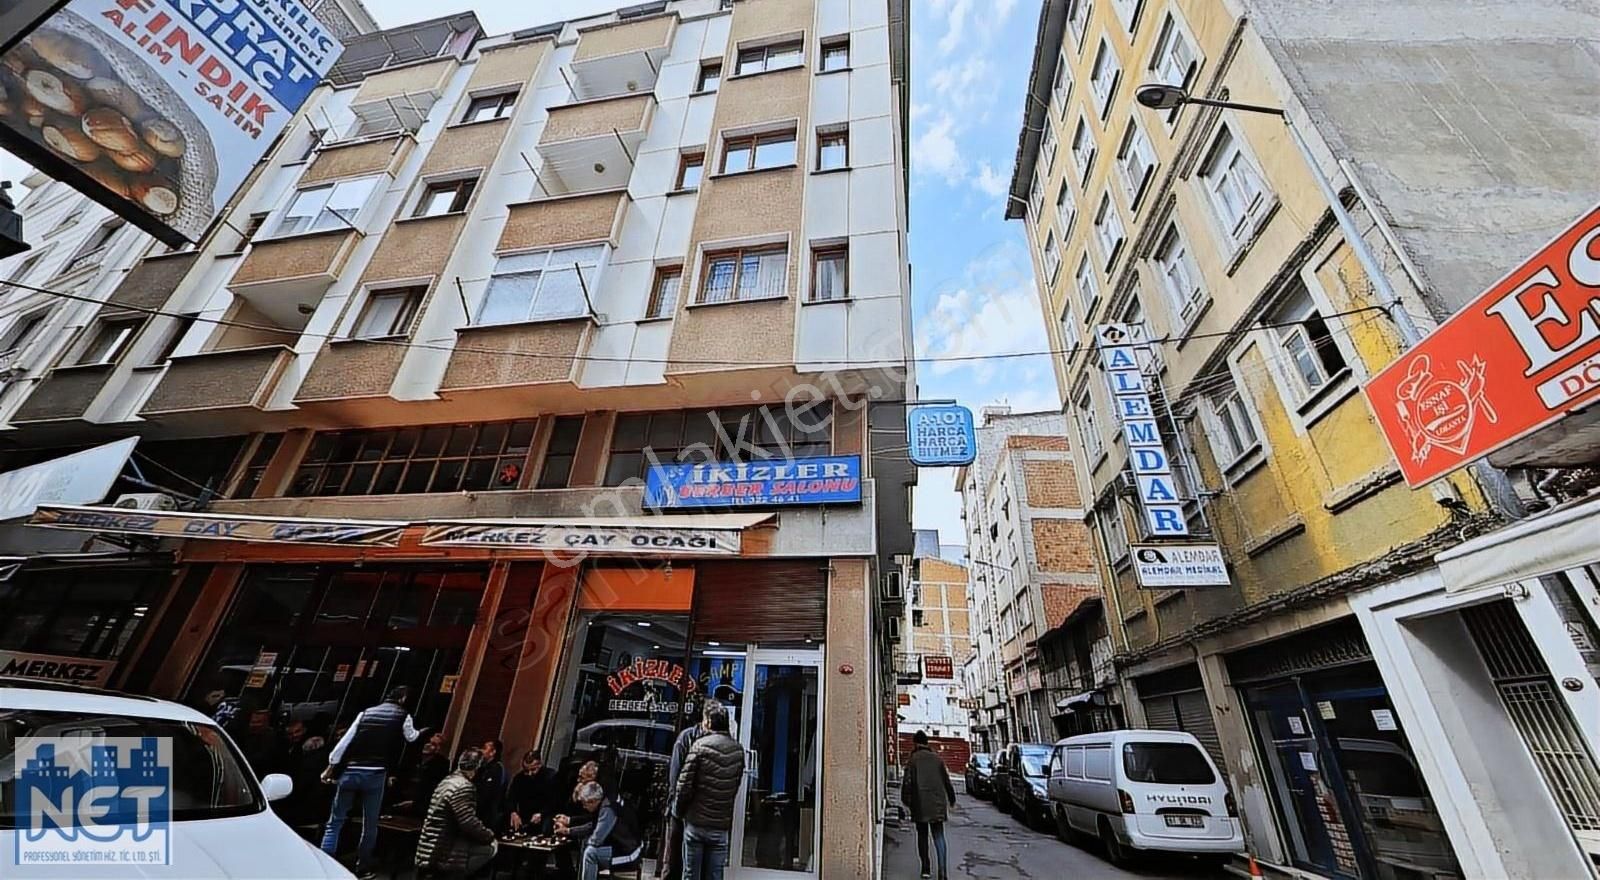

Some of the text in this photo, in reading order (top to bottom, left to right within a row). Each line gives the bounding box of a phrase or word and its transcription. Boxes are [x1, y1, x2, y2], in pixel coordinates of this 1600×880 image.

[115, 0, 276, 127] FINDIK
[102, 9, 173, 65] ALIM
[194, 82, 263, 140] SATIM
[917, 427, 966, 437] HARCA
[918, 437, 967, 447] HARCA
[1110, 349, 1184, 532] ALEMDAR
[692, 463, 849, 484] İKİZLER
[770, 478, 857, 496] SALONU
[564, 534, 617, 547] ÇAY
[631, 533, 717, 549] OCAĞI
[1171, 549, 1219, 564] ALEMDAR
[1142, 566, 1182, 575] ALEMDAR
[0, 658, 104, 680] MERKEZ
[608, 699, 648, 712] BERBER
[1147, 795, 1212, 805] HYUNDAI
